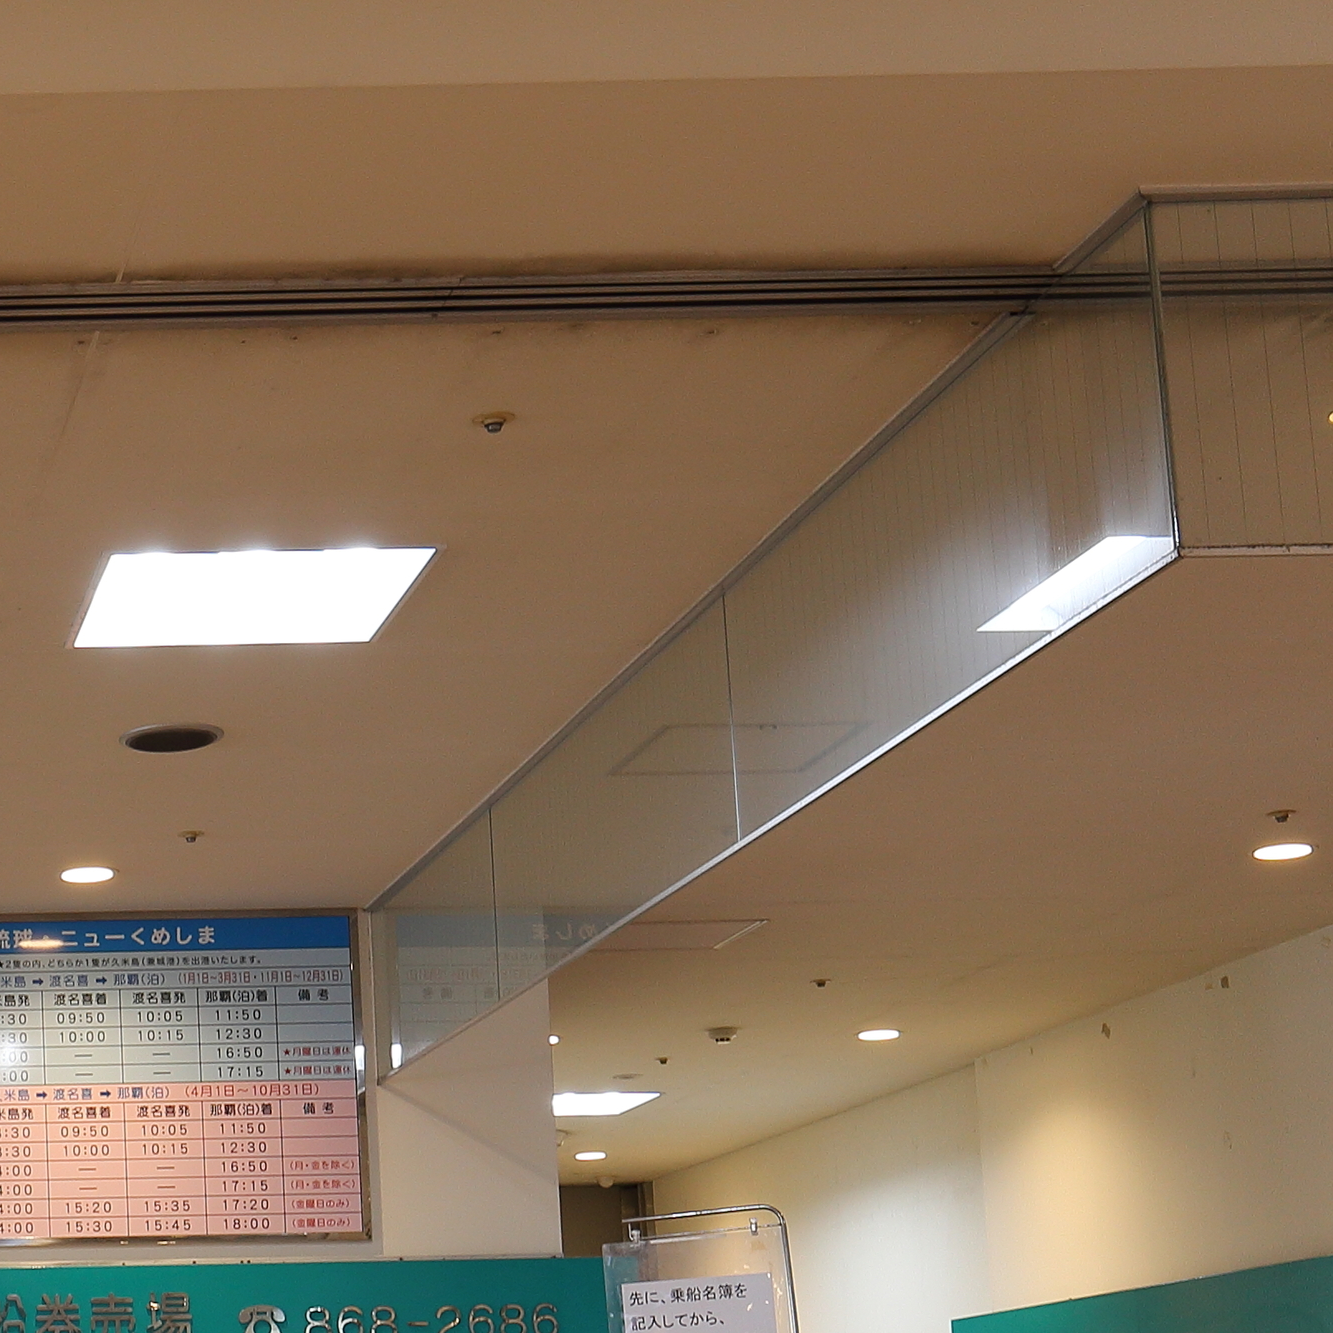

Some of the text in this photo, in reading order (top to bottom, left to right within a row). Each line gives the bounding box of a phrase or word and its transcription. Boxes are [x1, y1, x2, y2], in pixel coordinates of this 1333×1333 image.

[49, 974, 90, 988] 渡名喜
[215, 1010, 262, 1022] 11:50
[217, 1065, 264, 1078] 17:15
[61, 1122, 266, 1138] 09:50 10:05 11:50
[64, 1198, 270, 1214] 15:20 15:35 17:20
[629, 1282, 748, 1307] 先に、乗船名簿を
[630, 1310, 726, 1331] 記入してから、
